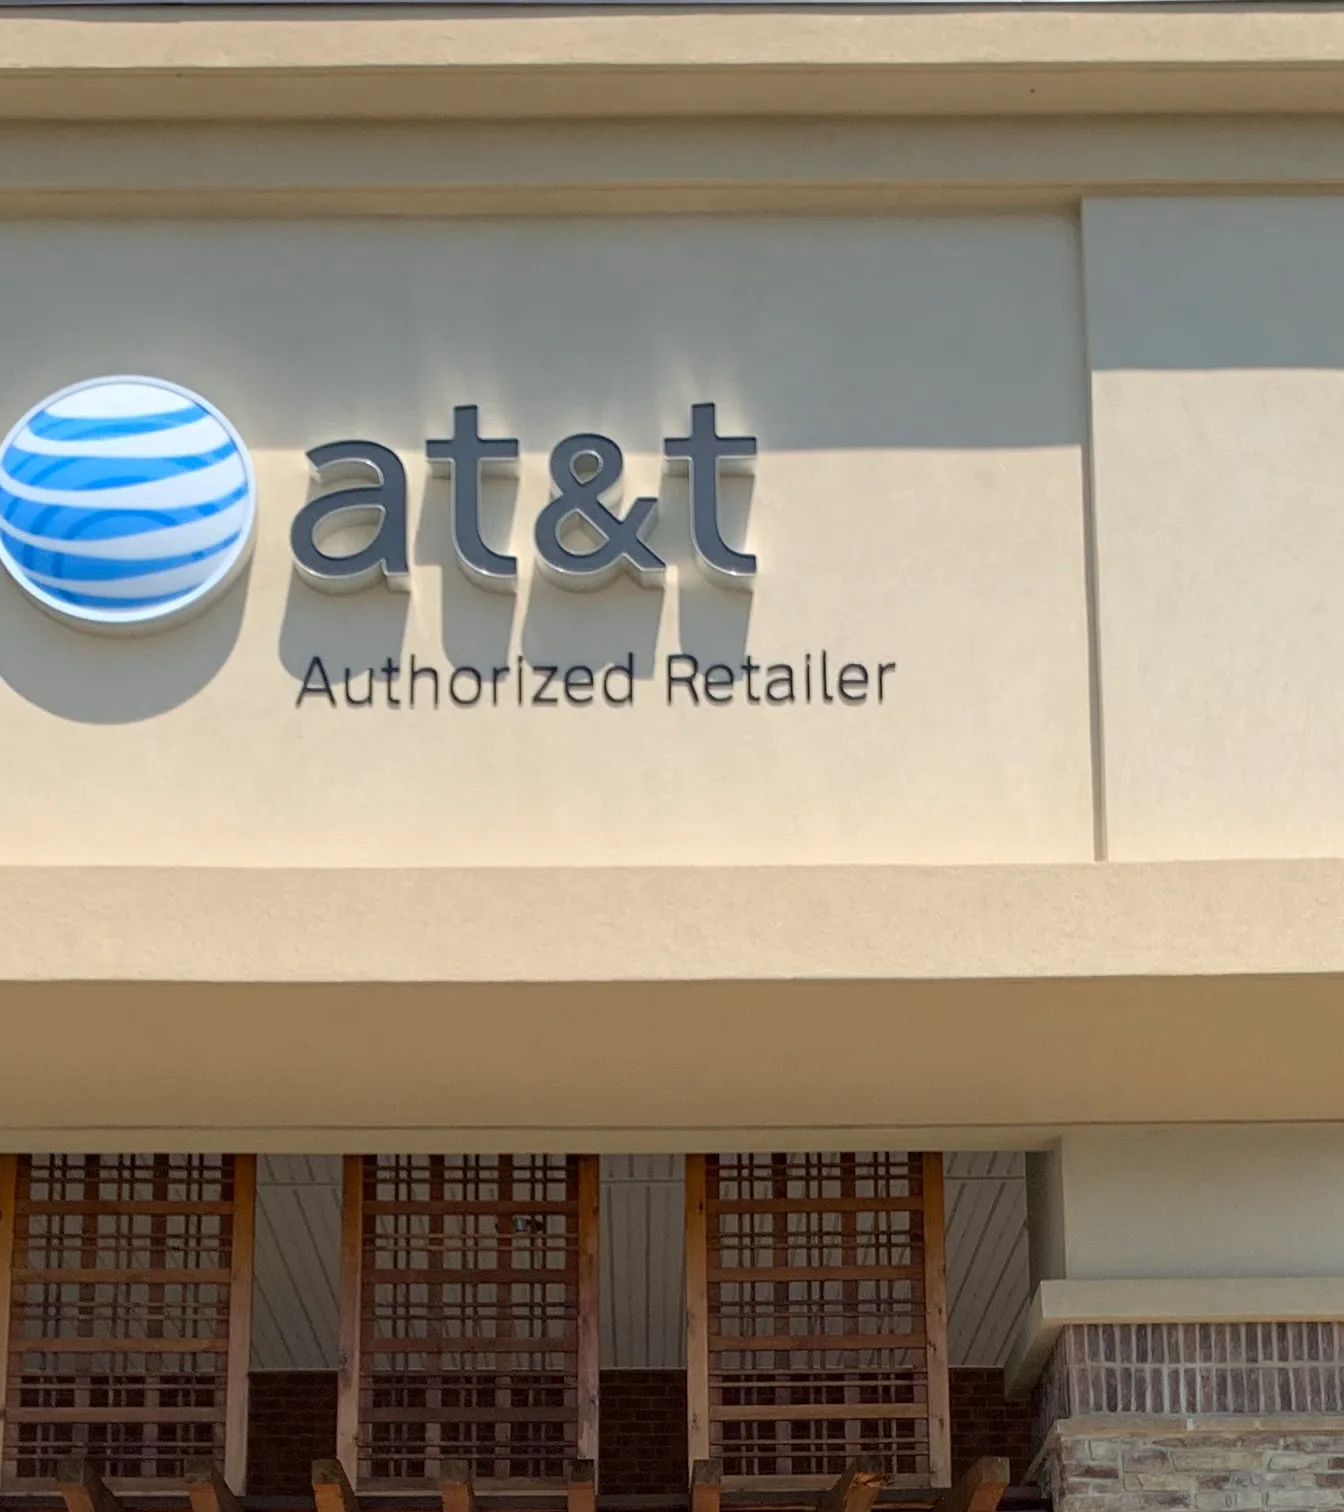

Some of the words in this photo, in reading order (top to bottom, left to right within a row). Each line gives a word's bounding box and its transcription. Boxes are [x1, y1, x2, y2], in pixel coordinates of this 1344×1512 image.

[290, 401, 759, 588] at&t
[295, 652, 635, 710] Authorized
[665, 650, 897, 708] Retailer
